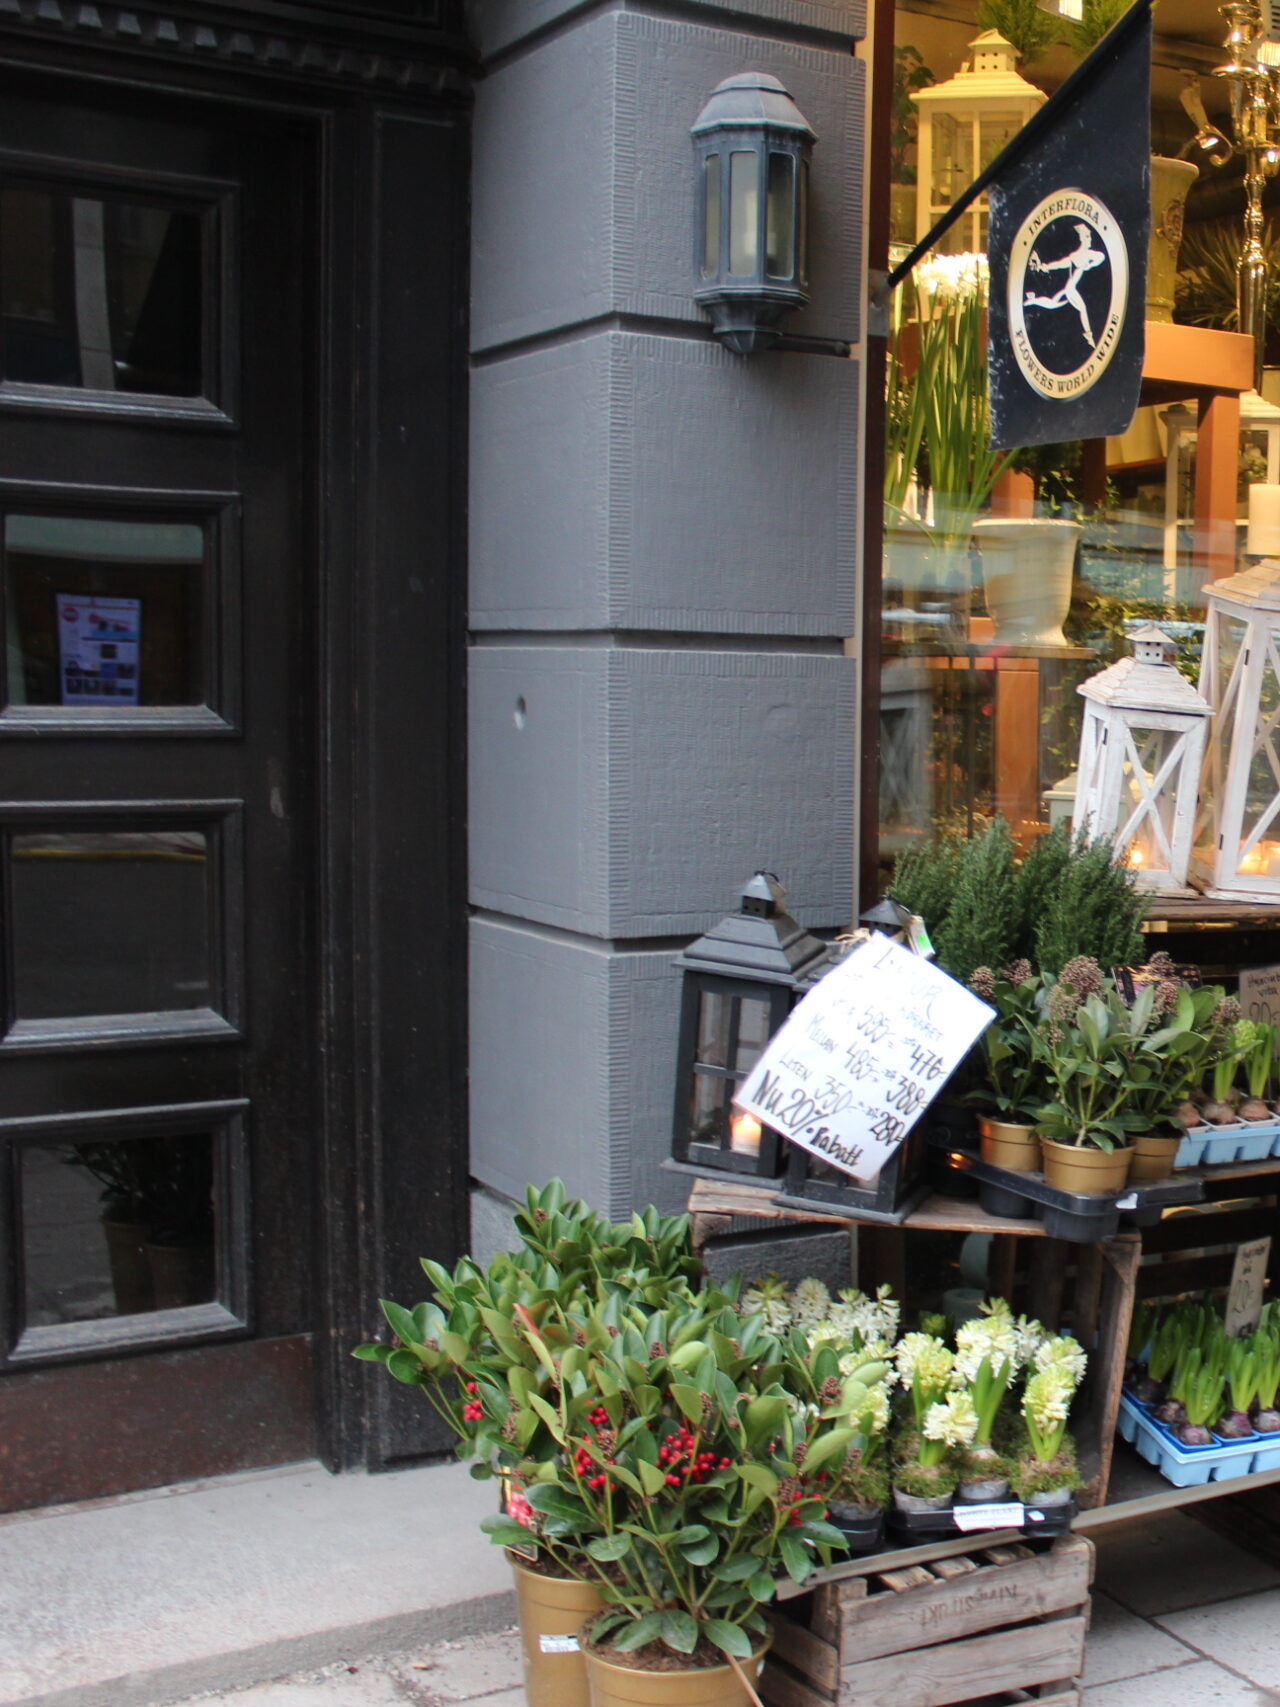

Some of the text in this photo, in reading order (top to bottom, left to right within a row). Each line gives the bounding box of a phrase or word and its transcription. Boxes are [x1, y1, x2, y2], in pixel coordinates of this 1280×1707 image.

[1028, 198, 1100, 238] INTERFLORA
[1015, 313, 1120, 393] FLOWERS WORLD WIDE
